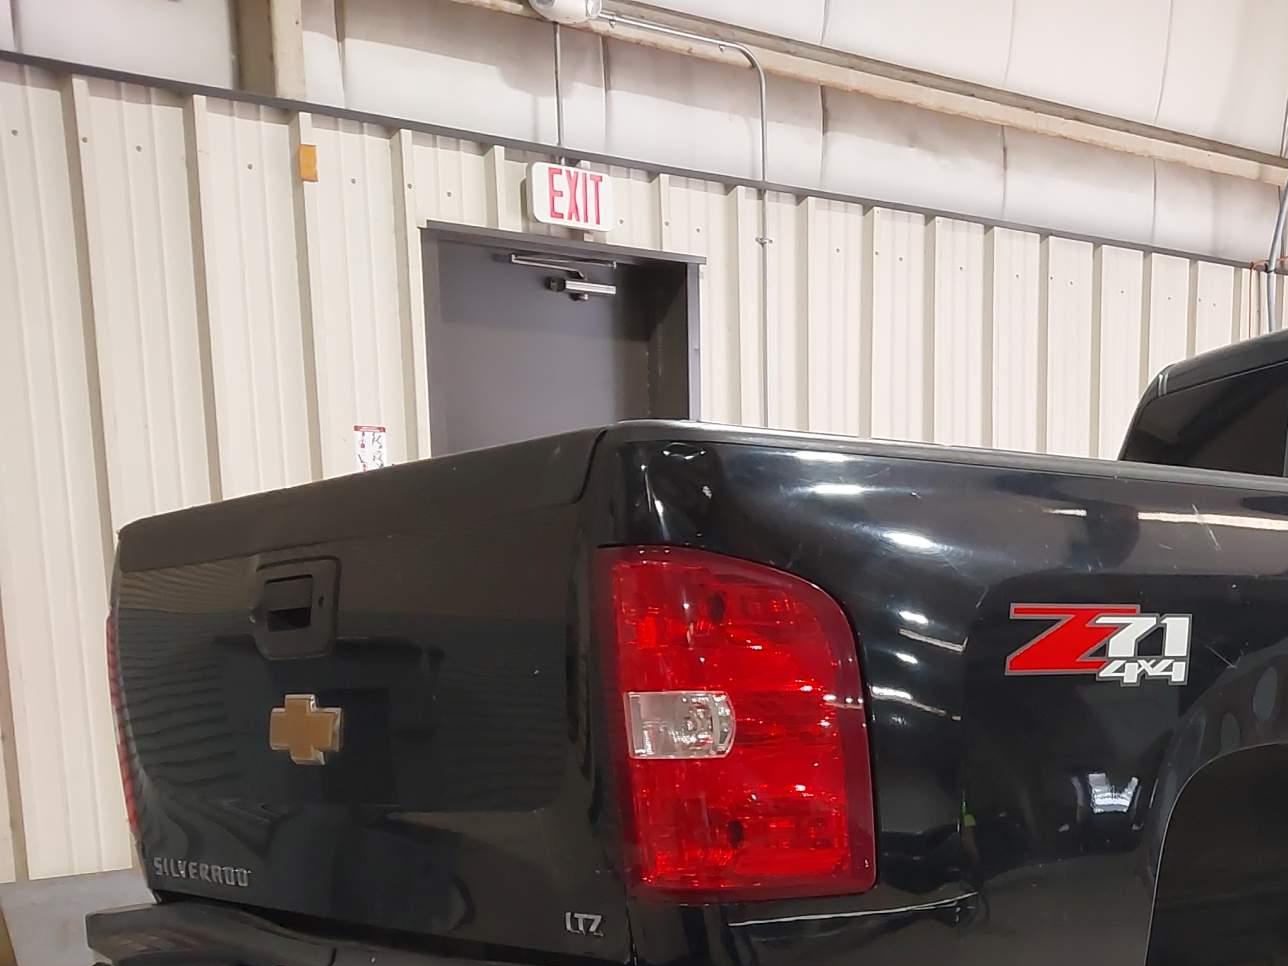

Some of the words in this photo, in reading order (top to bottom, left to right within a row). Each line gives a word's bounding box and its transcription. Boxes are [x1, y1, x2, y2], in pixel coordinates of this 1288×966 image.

[547, 166, 604, 226] EXIT
[1005, 603, 1192, 676] Z71
[153, 857, 251, 888] SILVERADO
[565, 911, 604, 937] LTZ
